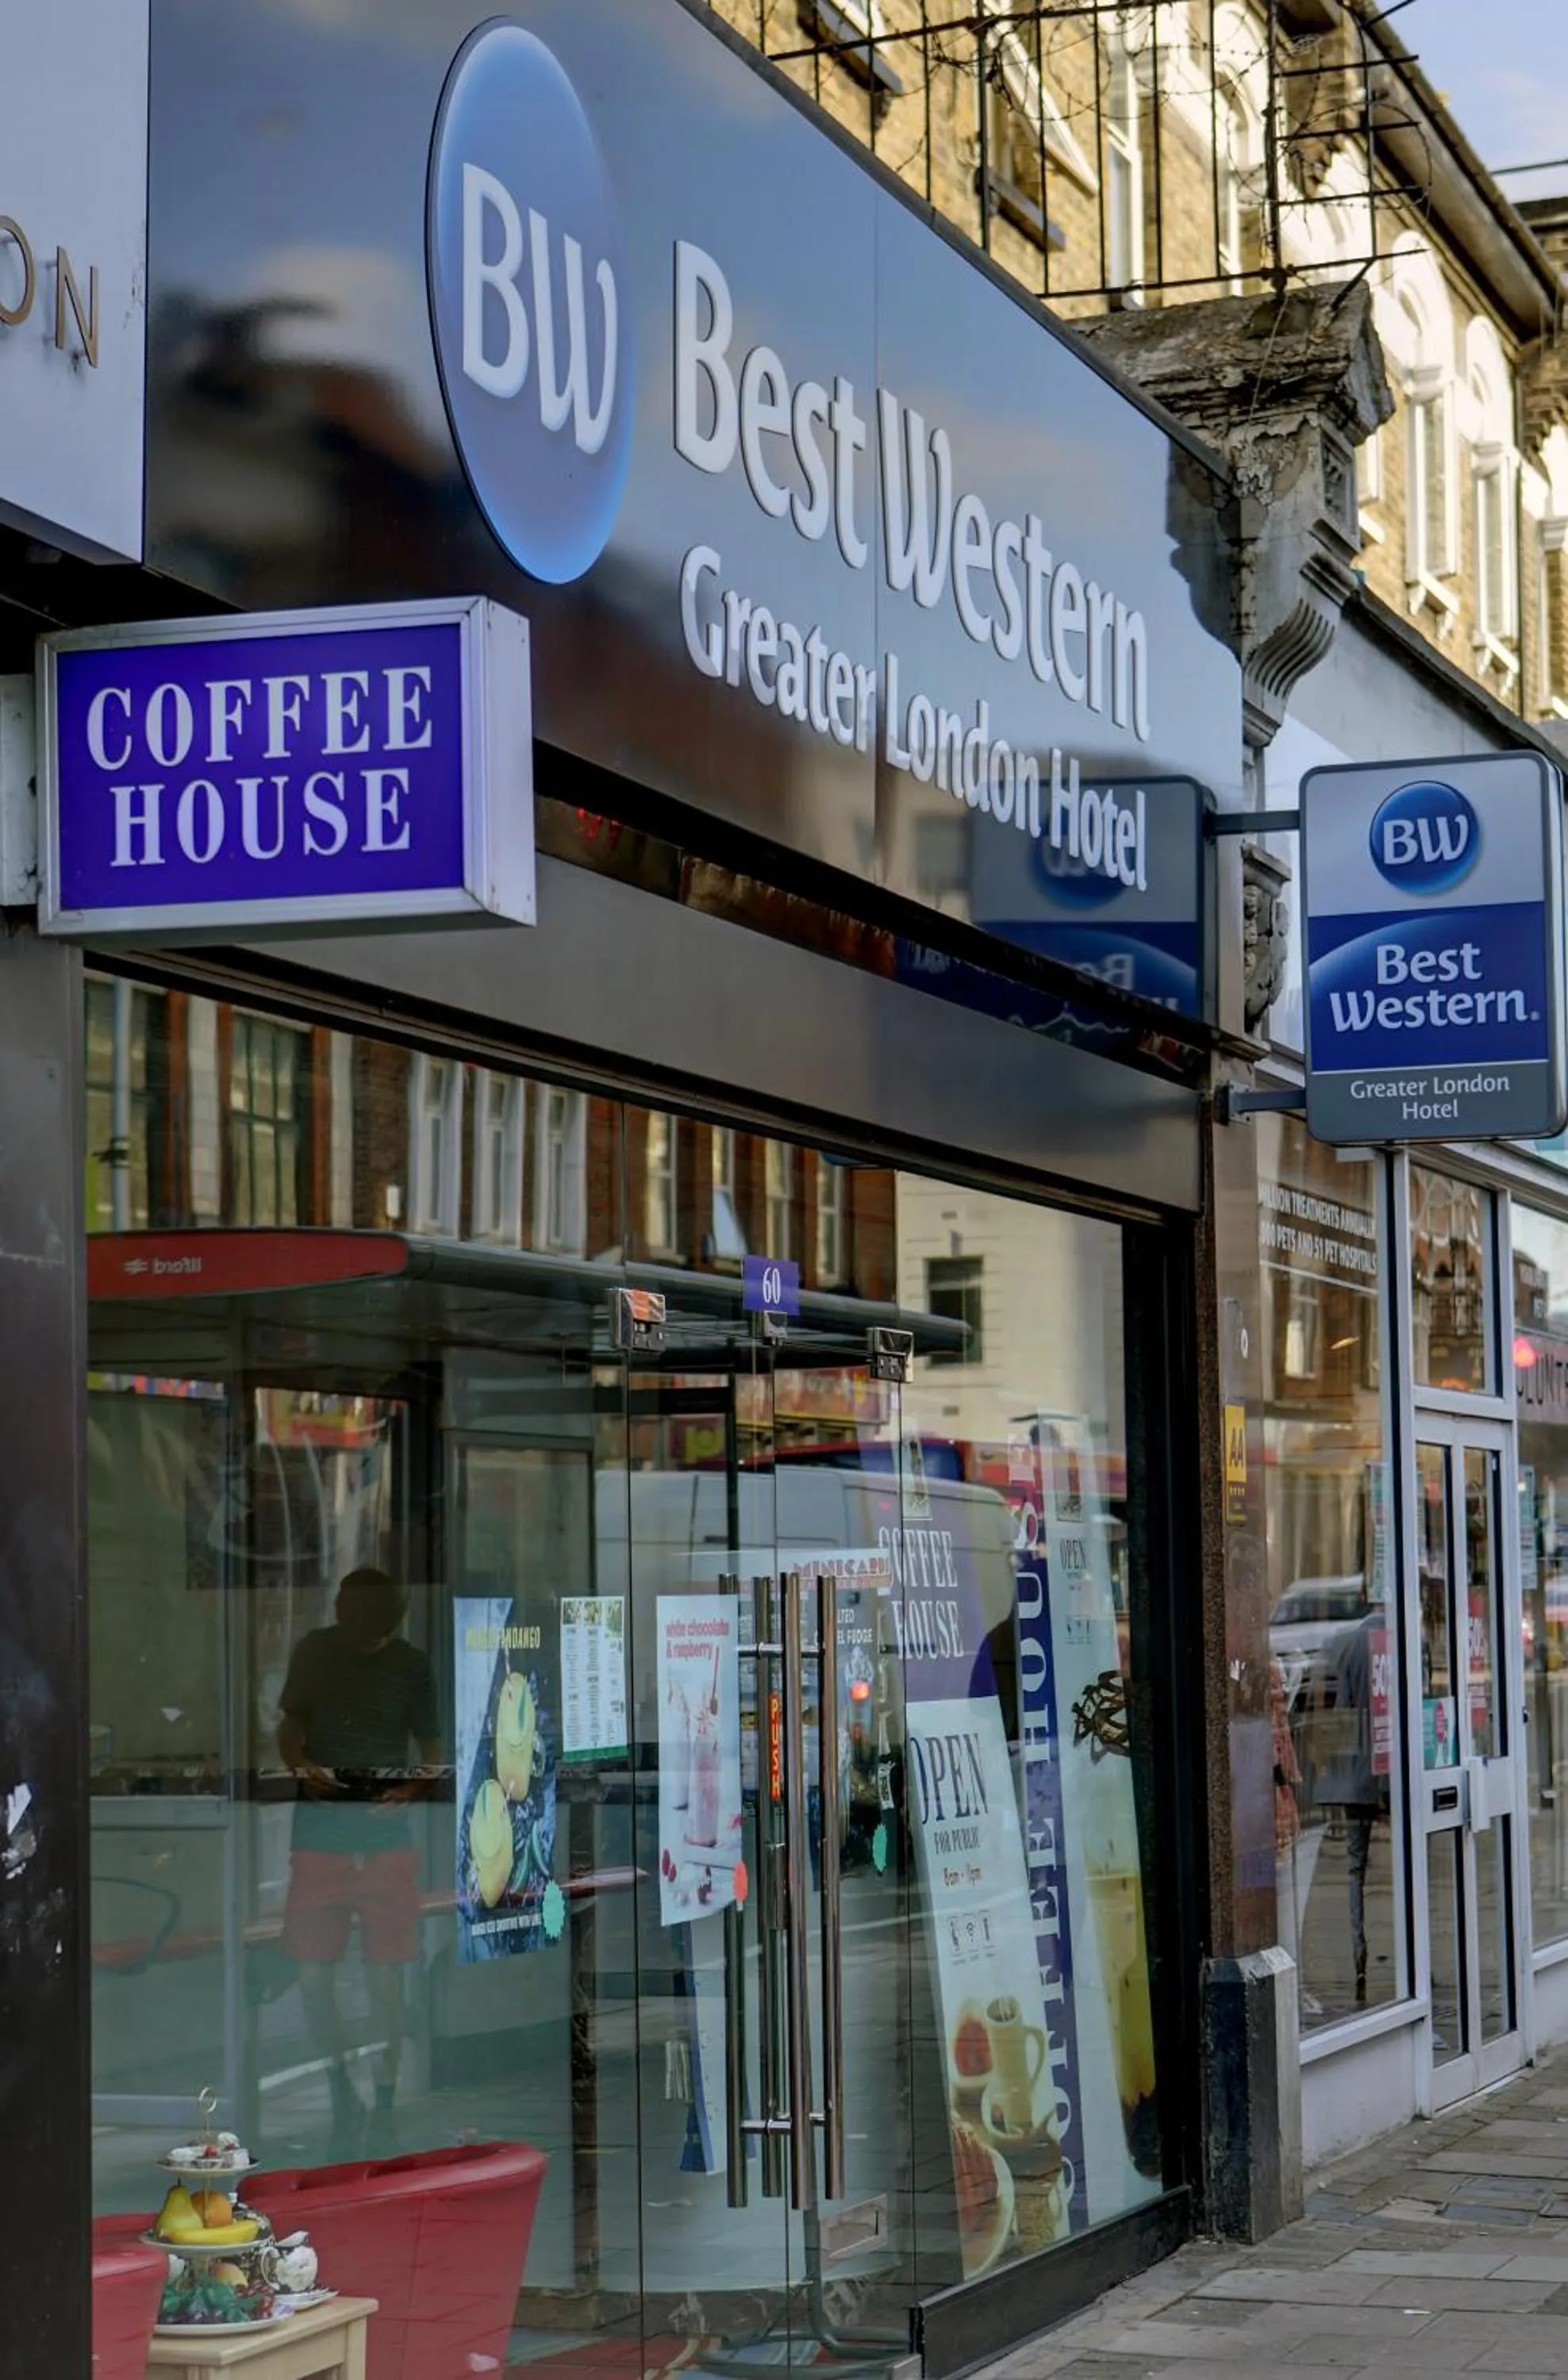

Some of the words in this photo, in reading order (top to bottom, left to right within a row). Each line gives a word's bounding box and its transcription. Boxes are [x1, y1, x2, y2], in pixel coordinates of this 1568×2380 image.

[463, 163, 617, 455] BW
[674, 240, 867, 569] Best
[878, 387, 1150, 741] Western
[86, 665, 432, 771] COFFEE
[681, 545, 876, 753] Greater
[884, 652, 1040, 839] London
[1051, 747, 1147, 891] Hotel
[110, 767, 410, 867] HOUSE
[1383, 814, 1469, 865] BW
[1377, 942, 1482, 985] Best
[1350, 1079, 1427, 1099] Greater
[1433, 1074, 1510, 1094] London
[1402, 1100, 1458, 1119] Hotel
[763, 1267, 782, 1306] 60
[770, 1698, 781, 1798] PUSH
[909, 1732, 989, 1825] OPEN
